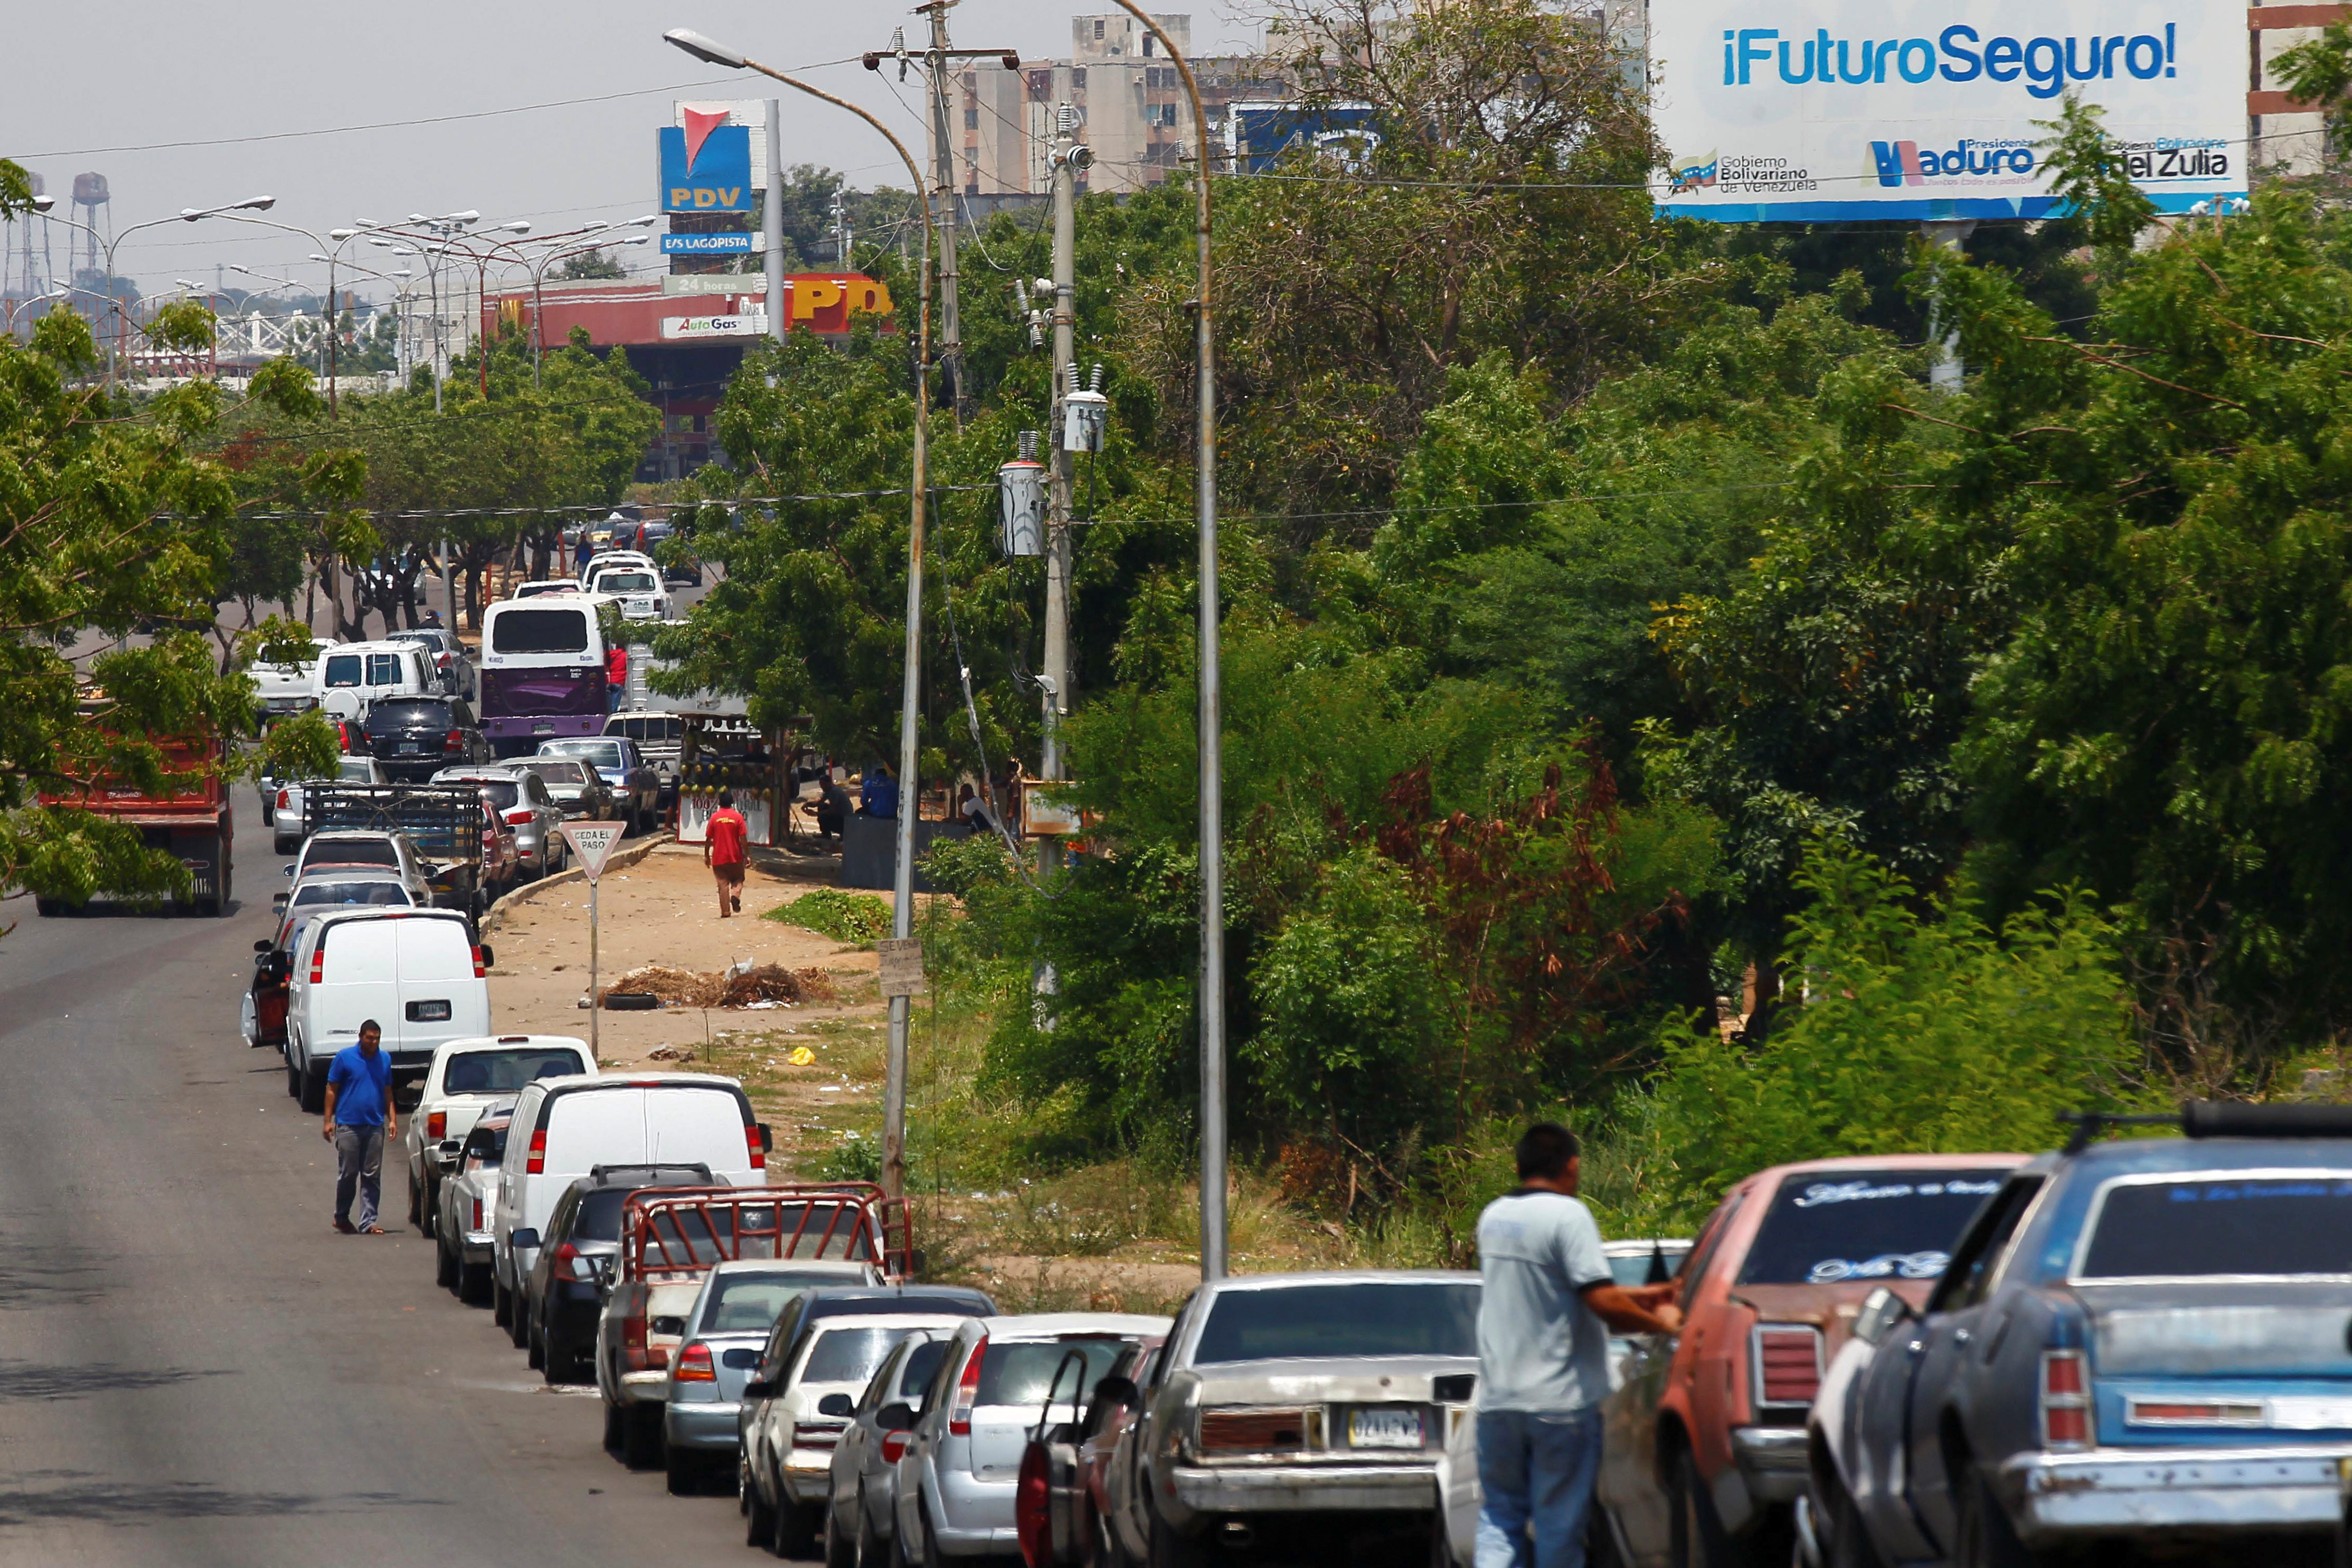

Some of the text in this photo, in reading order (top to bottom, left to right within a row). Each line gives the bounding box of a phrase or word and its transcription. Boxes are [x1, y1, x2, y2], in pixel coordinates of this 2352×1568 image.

[1723, 22, 2176, 99] ¡FuturoSeguro!
[1721, 156, 1787, 168] Gobierno
[1860, 139, 2034, 187] Maduro
[2158, 149, 2228, 176] Zulia
[1721, 167, 1808, 180] Bolivariano
[1721, 180, 1817, 193] de Venezuela
[671, 187, 740, 207] PDV
[666, 238, 683, 249] E/S
[679, 279, 737, 291] 24 horas
[678, 318, 737, 331] AutoGas
[575, 831, 611, 839] CEDA EL
